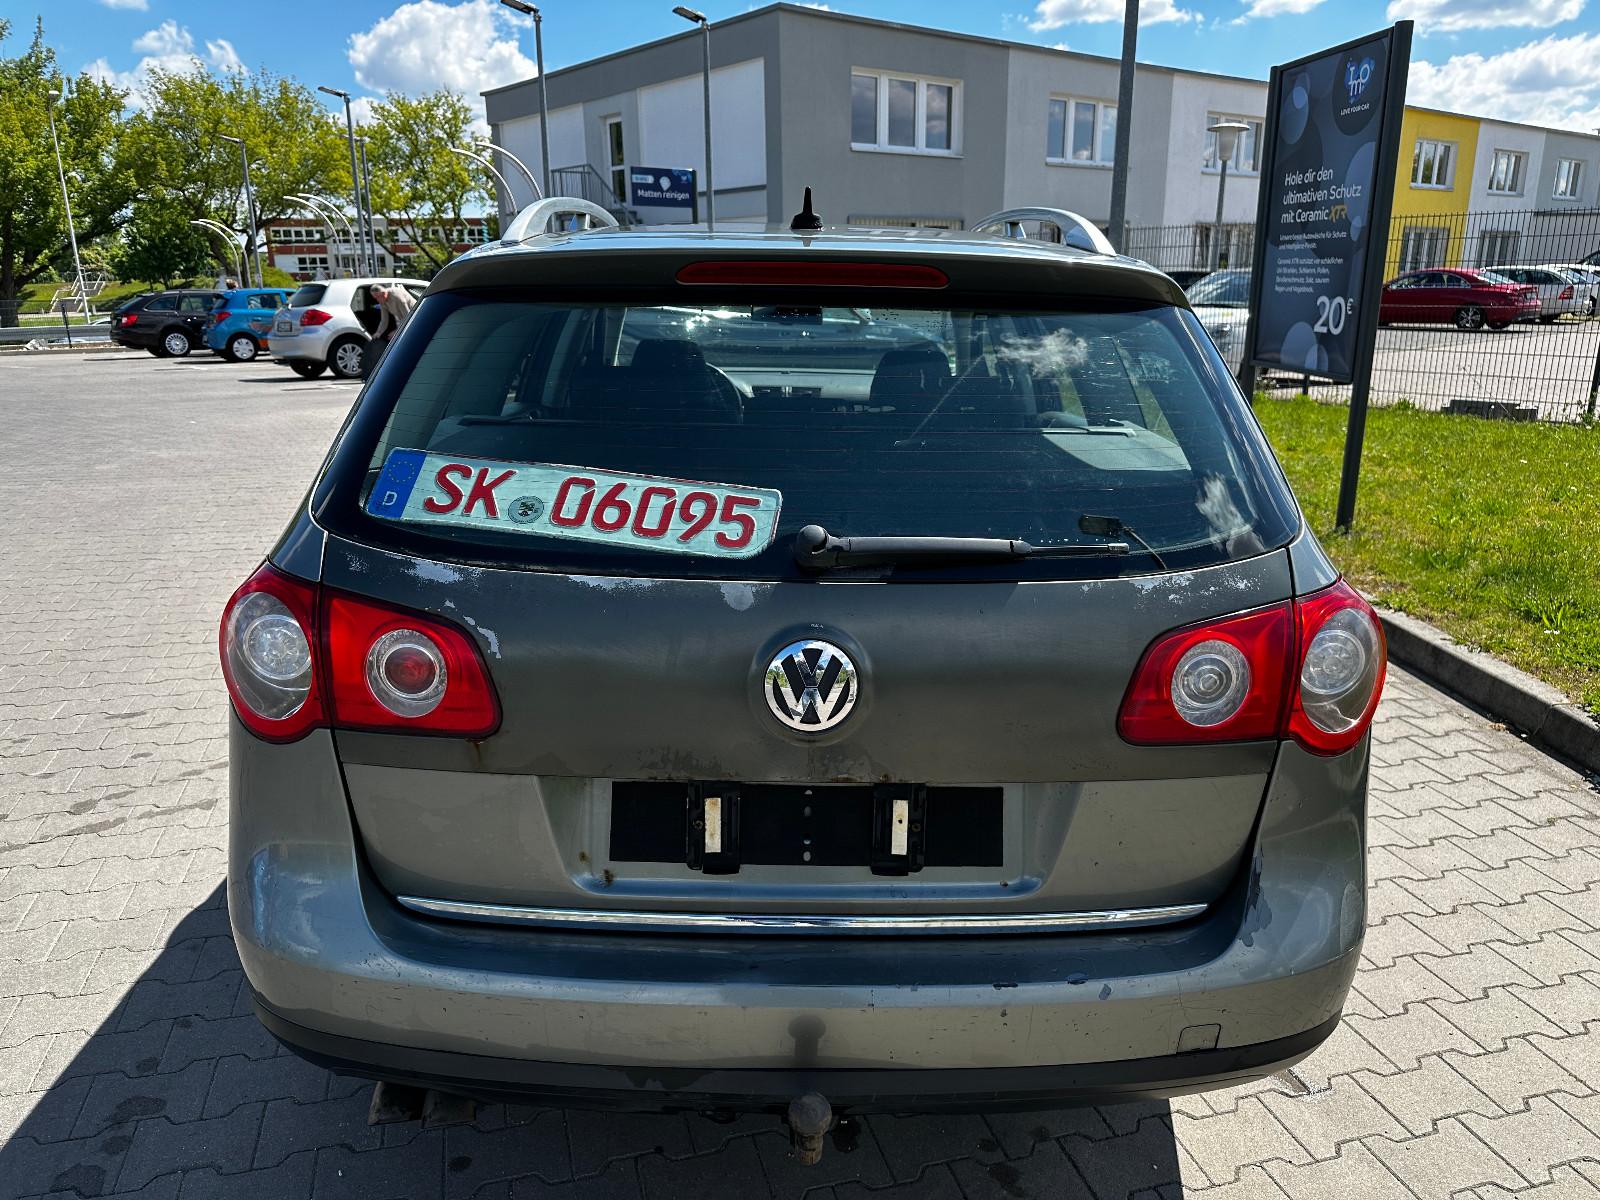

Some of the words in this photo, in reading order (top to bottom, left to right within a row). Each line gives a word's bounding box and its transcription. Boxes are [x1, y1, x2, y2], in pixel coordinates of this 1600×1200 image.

[1340, 107, 1350, 116] LOVE
[1361, 103, 1370, 111] CAR
[1284, 170, 1303, 187] Hole
[1303, 168, 1316, 183] dir
[1316, 165, 1334, 181] den
[637, 189, 662, 199] Matten
[662, 190, 690, 201] reinigen
[1282, 187, 1328, 205] ultimativen
[1329, 183, 1362, 200] Schutz
[1280, 209, 1295, 224] mit
[1295, 206, 1329, 223] Ceramic
[1328, 204, 1347, 223] XTR
[382, 490, 398, 506] D
[423, 463, 518, 518] SK
[551, 476, 762, 550] 06095
